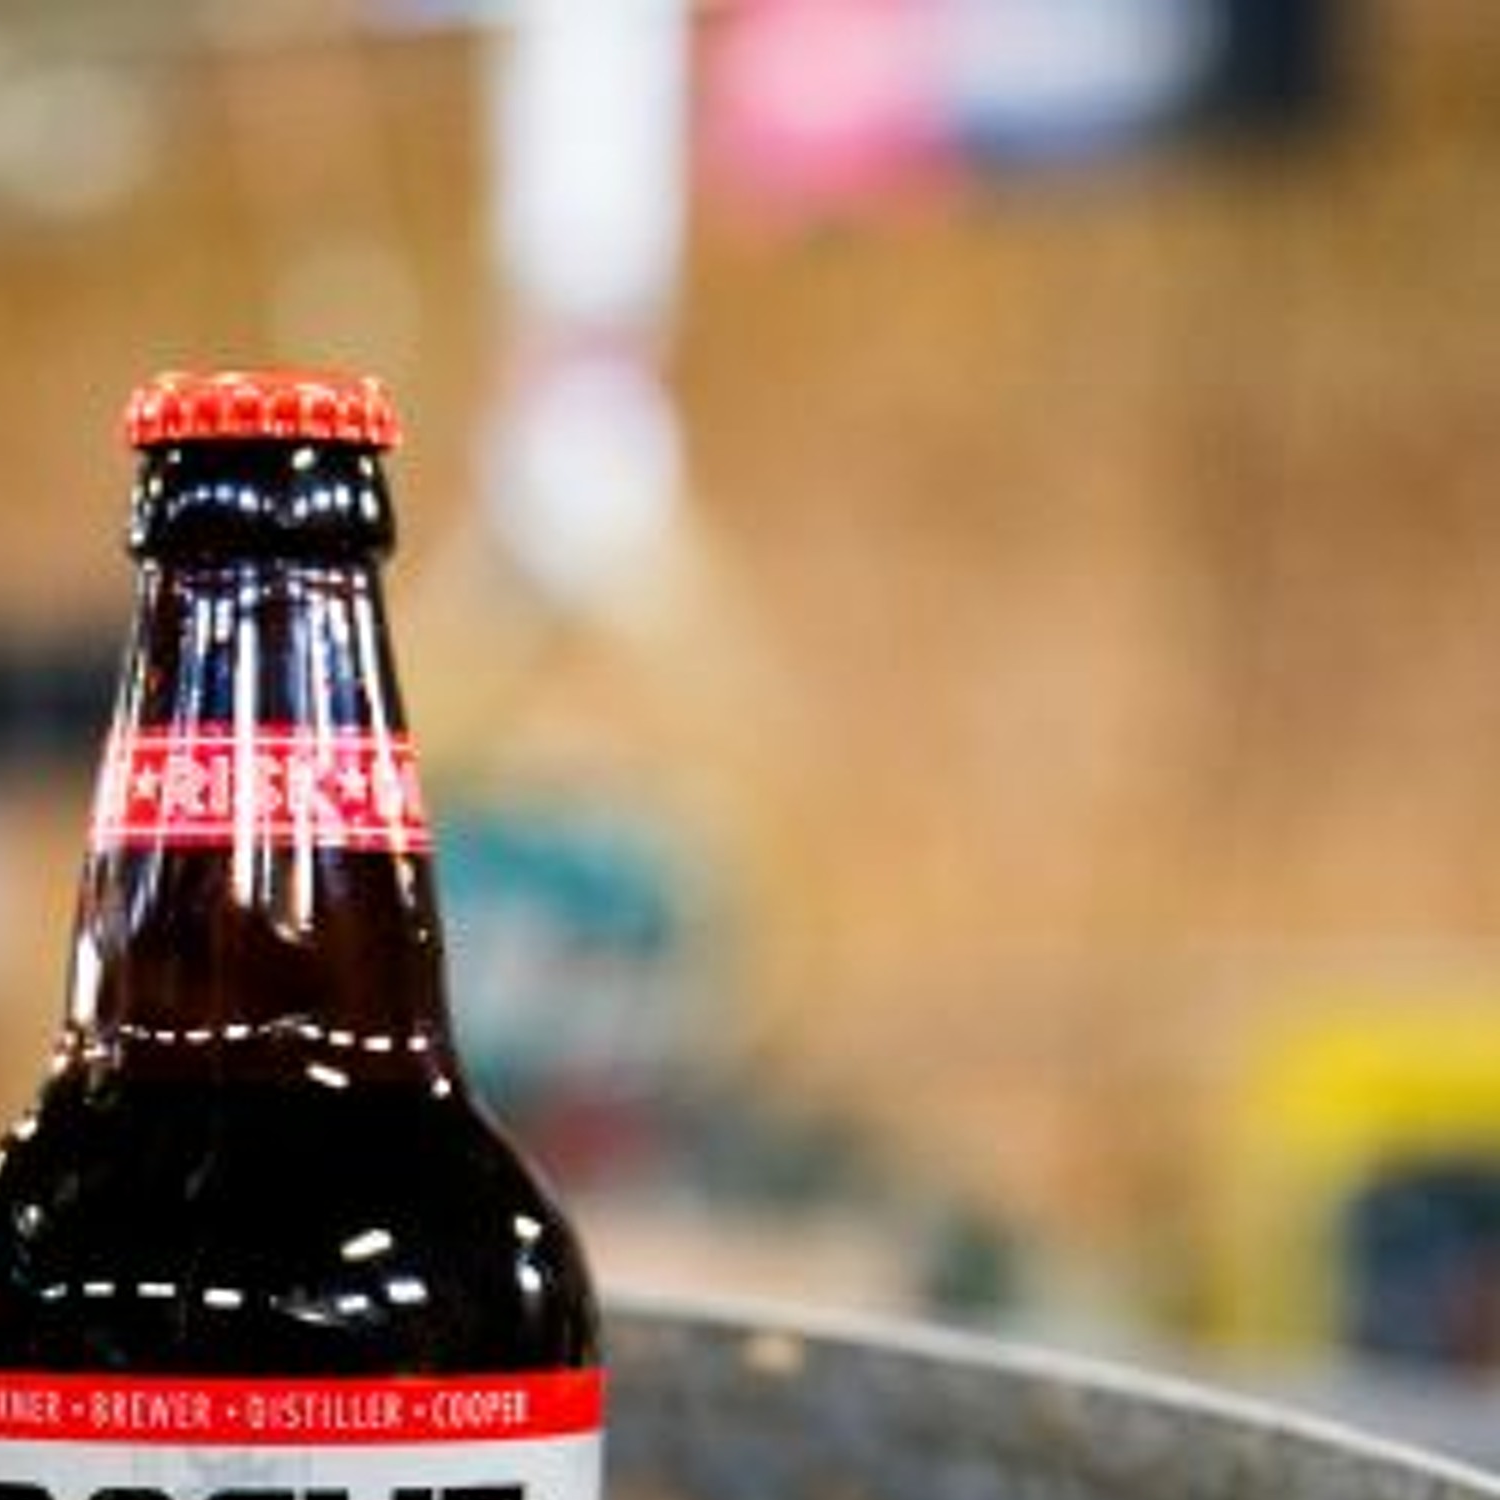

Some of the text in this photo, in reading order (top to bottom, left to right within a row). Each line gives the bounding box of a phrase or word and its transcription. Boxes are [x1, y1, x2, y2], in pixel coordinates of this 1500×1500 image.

[89, 1390, 211, 1430] BREWER
[247, 1390, 402, 1430] DISTILLER
[430, 1388, 530, 1428] COOPER
